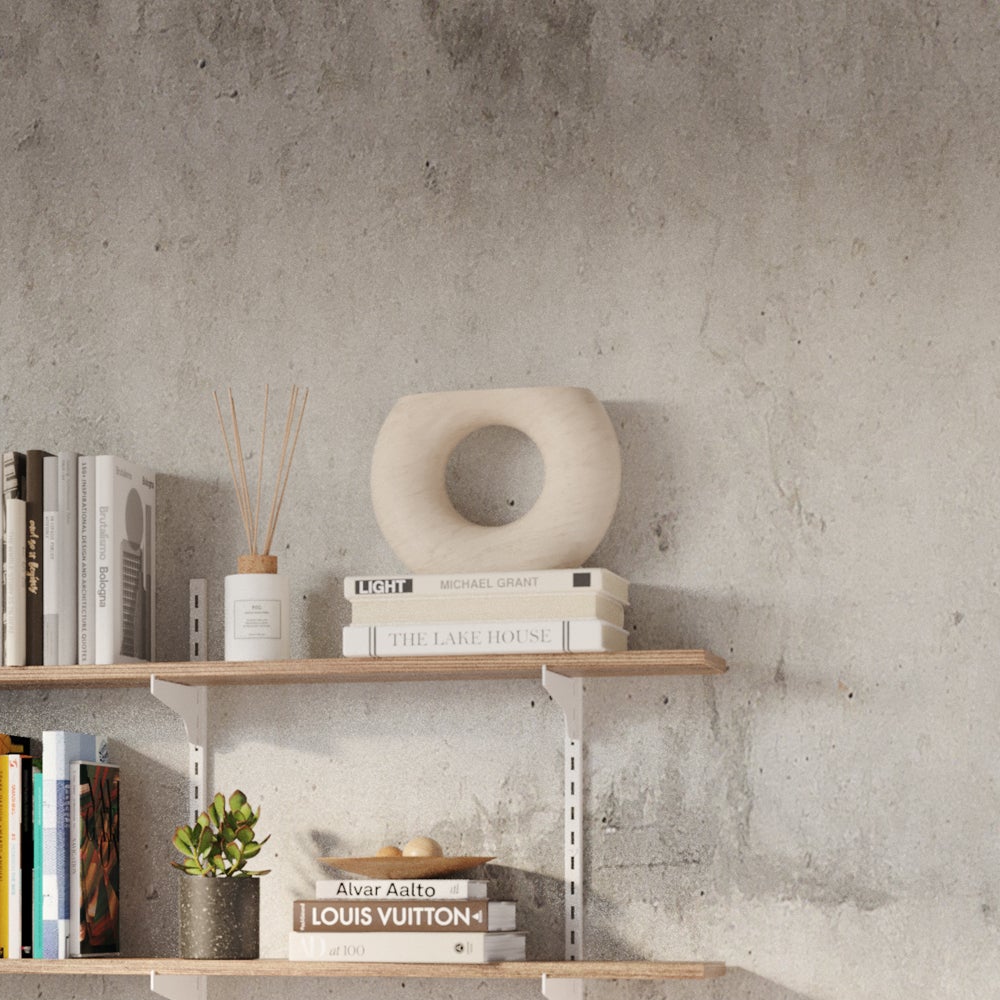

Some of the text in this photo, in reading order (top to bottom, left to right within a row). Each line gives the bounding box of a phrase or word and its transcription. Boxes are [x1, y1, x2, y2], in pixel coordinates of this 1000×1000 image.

[29, 520, 39, 538] and
[97, 506, 109, 608] Brutalismo Bologna
[25, 562, 40, 595] begins
[359, 579, 406, 594] LIGHT
[440, 577, 539, 592] MICHAEL GRANT
[388, 628, 552, 647] THE LAKE HOUSE
[337, 882, 381, 896] Alvar
[387, 882, 436, 897] Aalto
[311, 906, 373, 926] LOUIS
[377, 906, 470, 926] VUITTON
[328, 944, 365, 956] at 100
